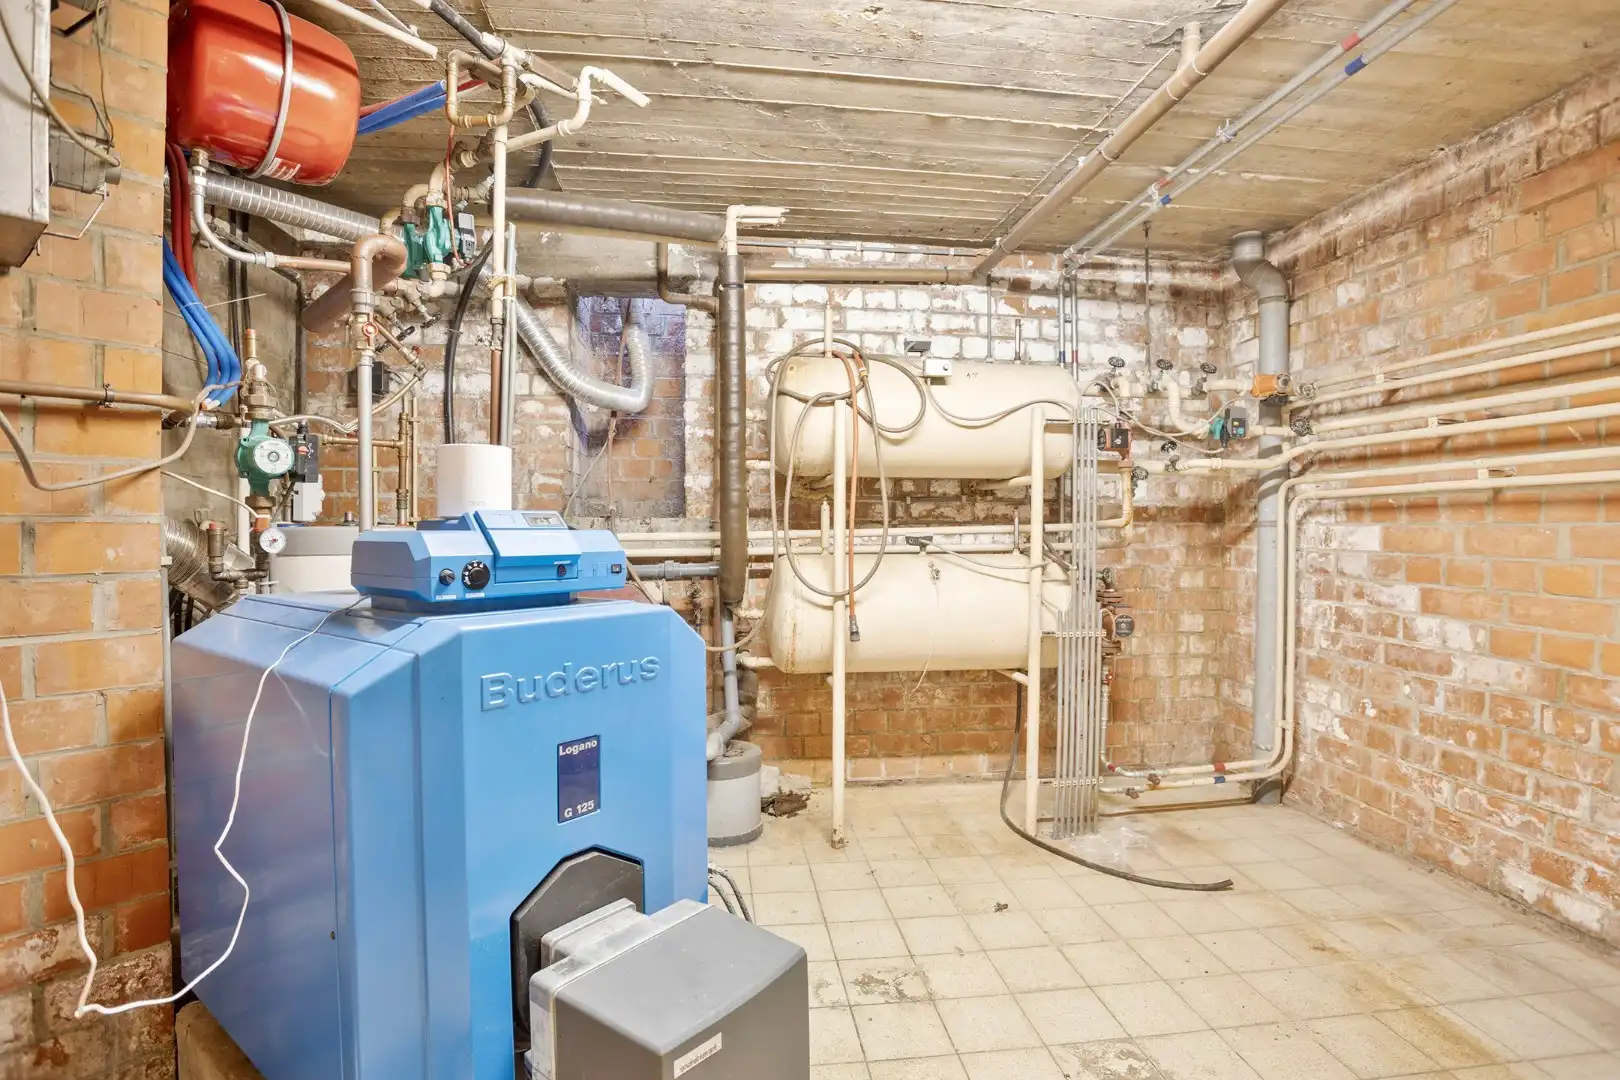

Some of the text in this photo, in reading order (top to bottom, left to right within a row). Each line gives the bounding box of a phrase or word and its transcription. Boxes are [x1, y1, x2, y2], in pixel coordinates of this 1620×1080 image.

[480, 656, 661, 712] Buderus
[559, 739, 598, 756] Logano
[564, 800, 595, 818] G 125
